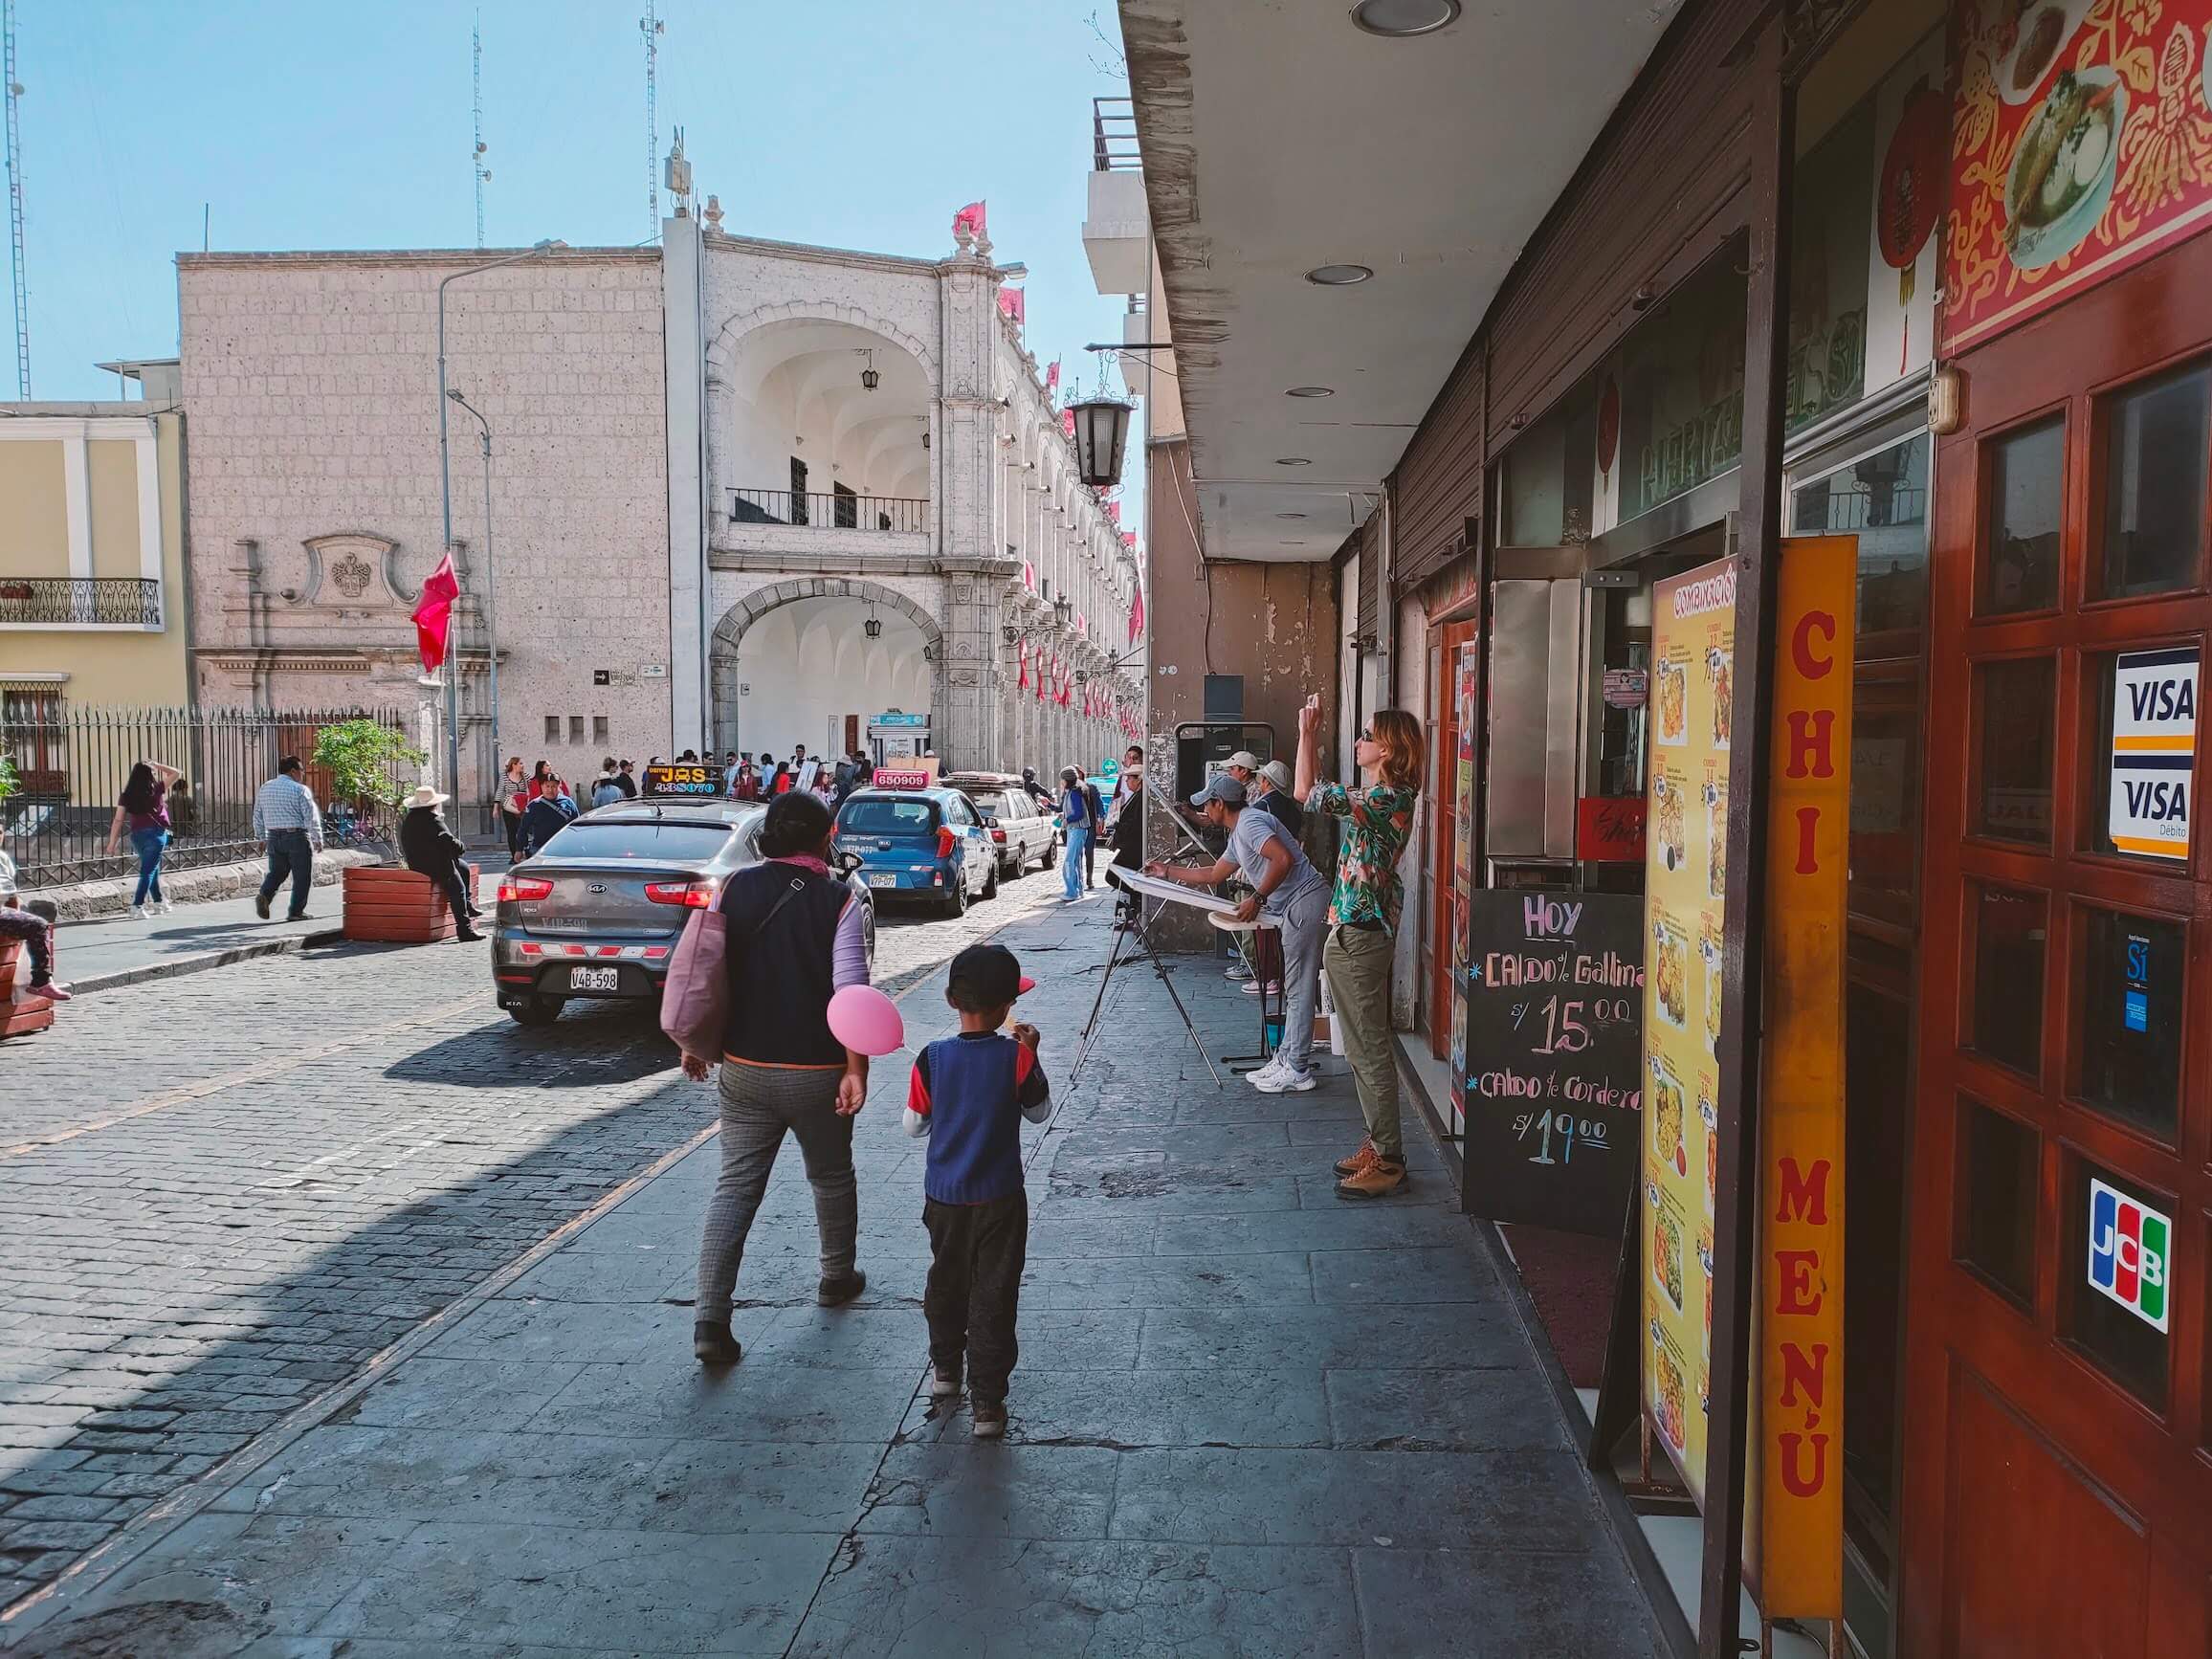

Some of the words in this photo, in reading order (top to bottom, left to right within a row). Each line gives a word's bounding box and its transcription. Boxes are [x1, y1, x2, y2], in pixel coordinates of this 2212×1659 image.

[2126, 678, 2195, 721] VISA
[878, 776, 923, 785] 650909
[2121, 781, 2187, 822] VISA
[2159, 824, 2187, 838] Débito
[587, 884, 608, 894] KIA
[1523, 894, 1583, 937] HOY
[572, 973, 616, 988] V4B-598
[2127, 942, 2149, 982] Sí
[2092, 1224, 2163, 1288] JCB
[1774, 1157, 1831, 1498] MENÚ
